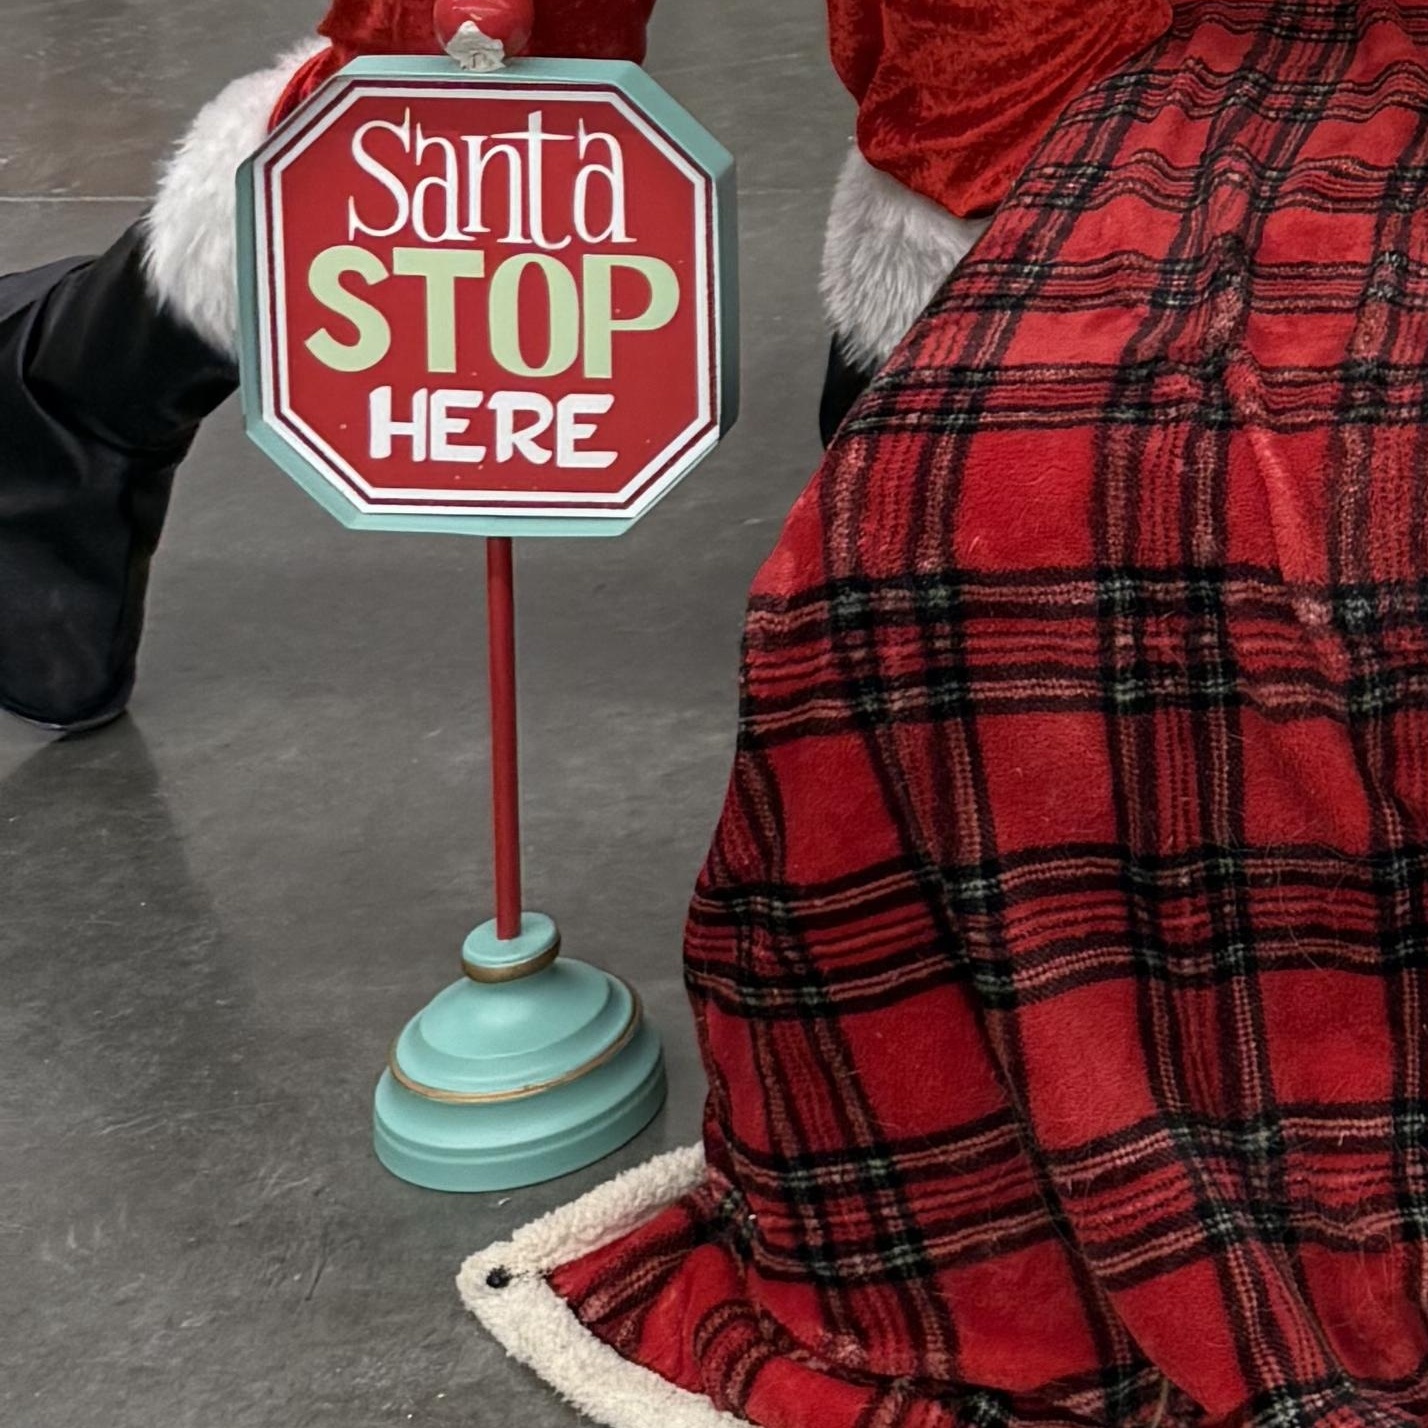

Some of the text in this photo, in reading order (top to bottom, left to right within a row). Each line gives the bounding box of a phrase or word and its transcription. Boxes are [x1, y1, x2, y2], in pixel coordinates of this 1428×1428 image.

[348, 107, 637, 250] Santa
[304, 245, 681, 379] STOP
[368, 385, 619, 469] HERE
